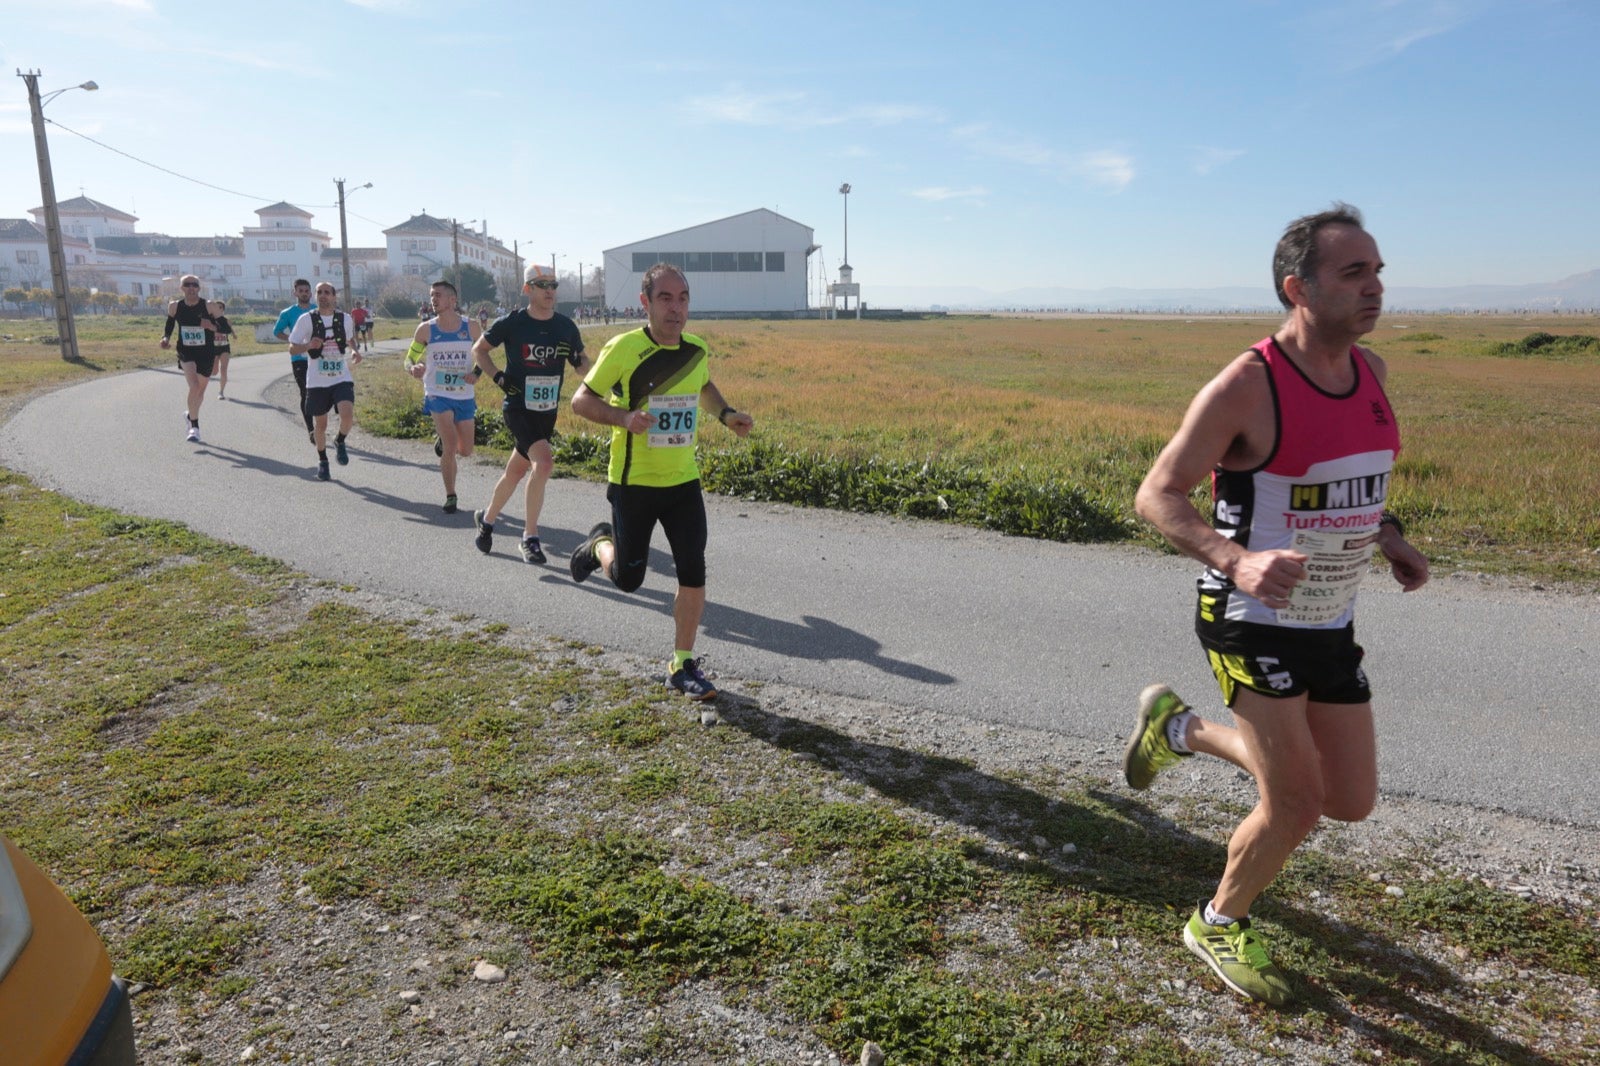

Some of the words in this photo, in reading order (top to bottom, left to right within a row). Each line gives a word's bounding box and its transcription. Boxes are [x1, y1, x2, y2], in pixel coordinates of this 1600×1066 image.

[184, 332, 202, 340] 836
[322, 361, 341, 371] 835
[444, 373, 458, 385] 97
[532, 386, 555, 401] 581
[658, 410, 693, 431] 876
[1306, 563, 1346, 573] CORRO
[1309, 574, 1323, 582] EL
